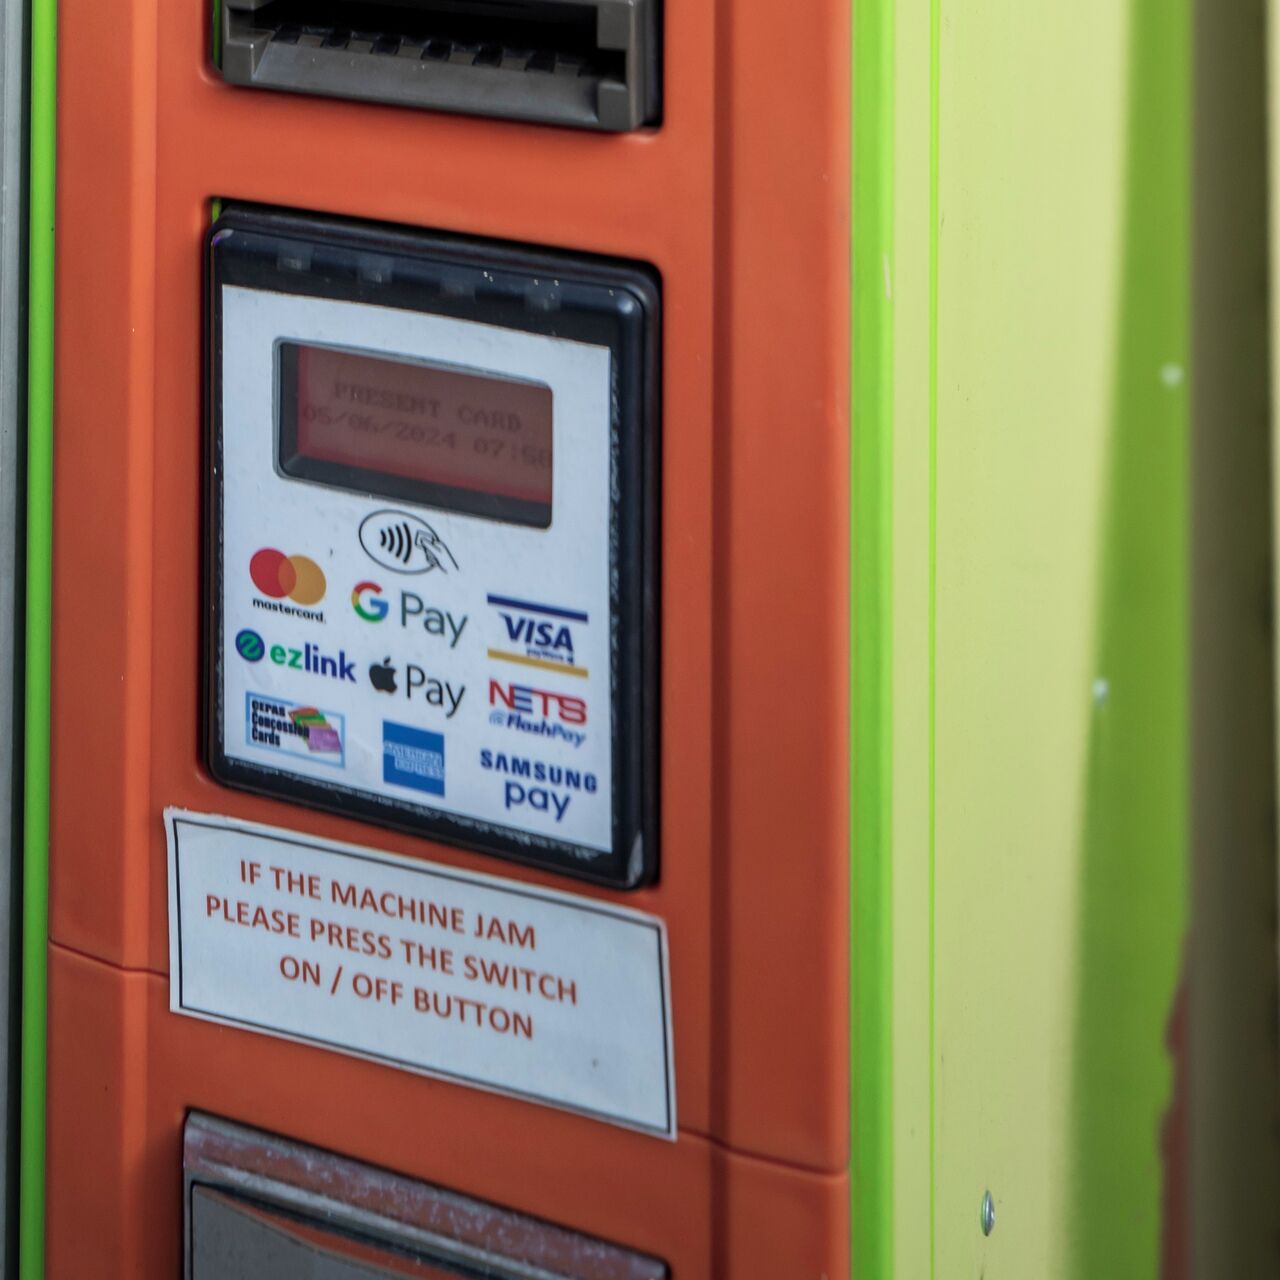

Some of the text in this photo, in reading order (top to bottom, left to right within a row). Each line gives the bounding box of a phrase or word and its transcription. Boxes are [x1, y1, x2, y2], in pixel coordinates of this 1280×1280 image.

[334, 381, 522, 432] PRESENT CARD
[401, 591, 468, 647] Pay
[500, 613, 574, 652] VISA
[270, 642, 357, 683] ezlink
[406, 665, 466, 718] Pay
[489, 679, 587, 725] NETS
[252, 726, 280, 747] Cards
[480, 749, 597, 793] SAMSUNG
[505, 779, 570, 822] pay
[240, 860, 536, 950] IF THE MACHINE JAM
[207, 895, 577, 1005] PLEASE PRESS THE SWITCH
[280, 956, 533, 1040] ON / OFF BUTTON
